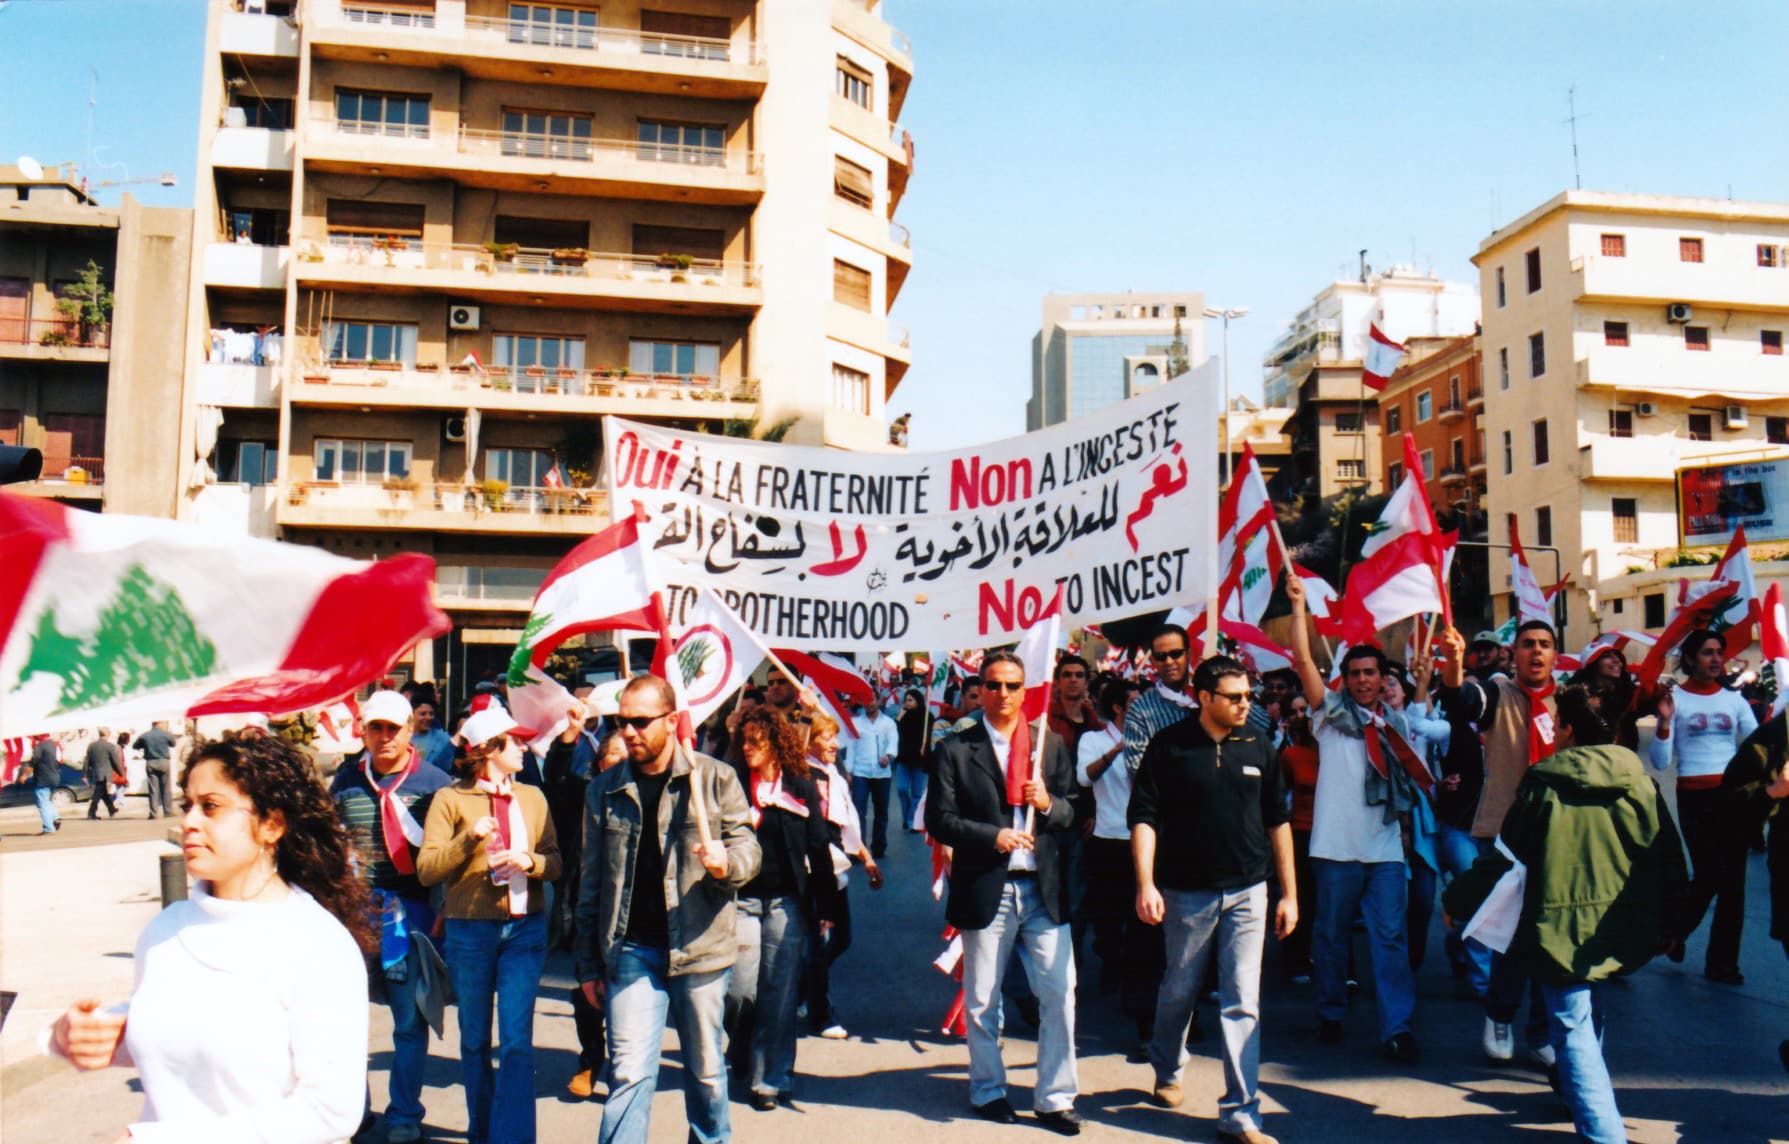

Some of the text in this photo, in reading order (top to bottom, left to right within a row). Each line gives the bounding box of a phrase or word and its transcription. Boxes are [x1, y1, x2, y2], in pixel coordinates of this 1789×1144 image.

[616, 431, 683, 490] Oui
[712, 459, 744, 504] LA
[755, 465, 931, 515] FRATERNITÉ
[950, 455, 1033, 511] Non
[1038, 452, 1057, 495] A
[809, 519, 868, 576] لا
[712, 587, 910, 641] ROTHERHOOD
[978, 578, 1042, 632] No
[1092, 547, 1190, 612] INCEST
